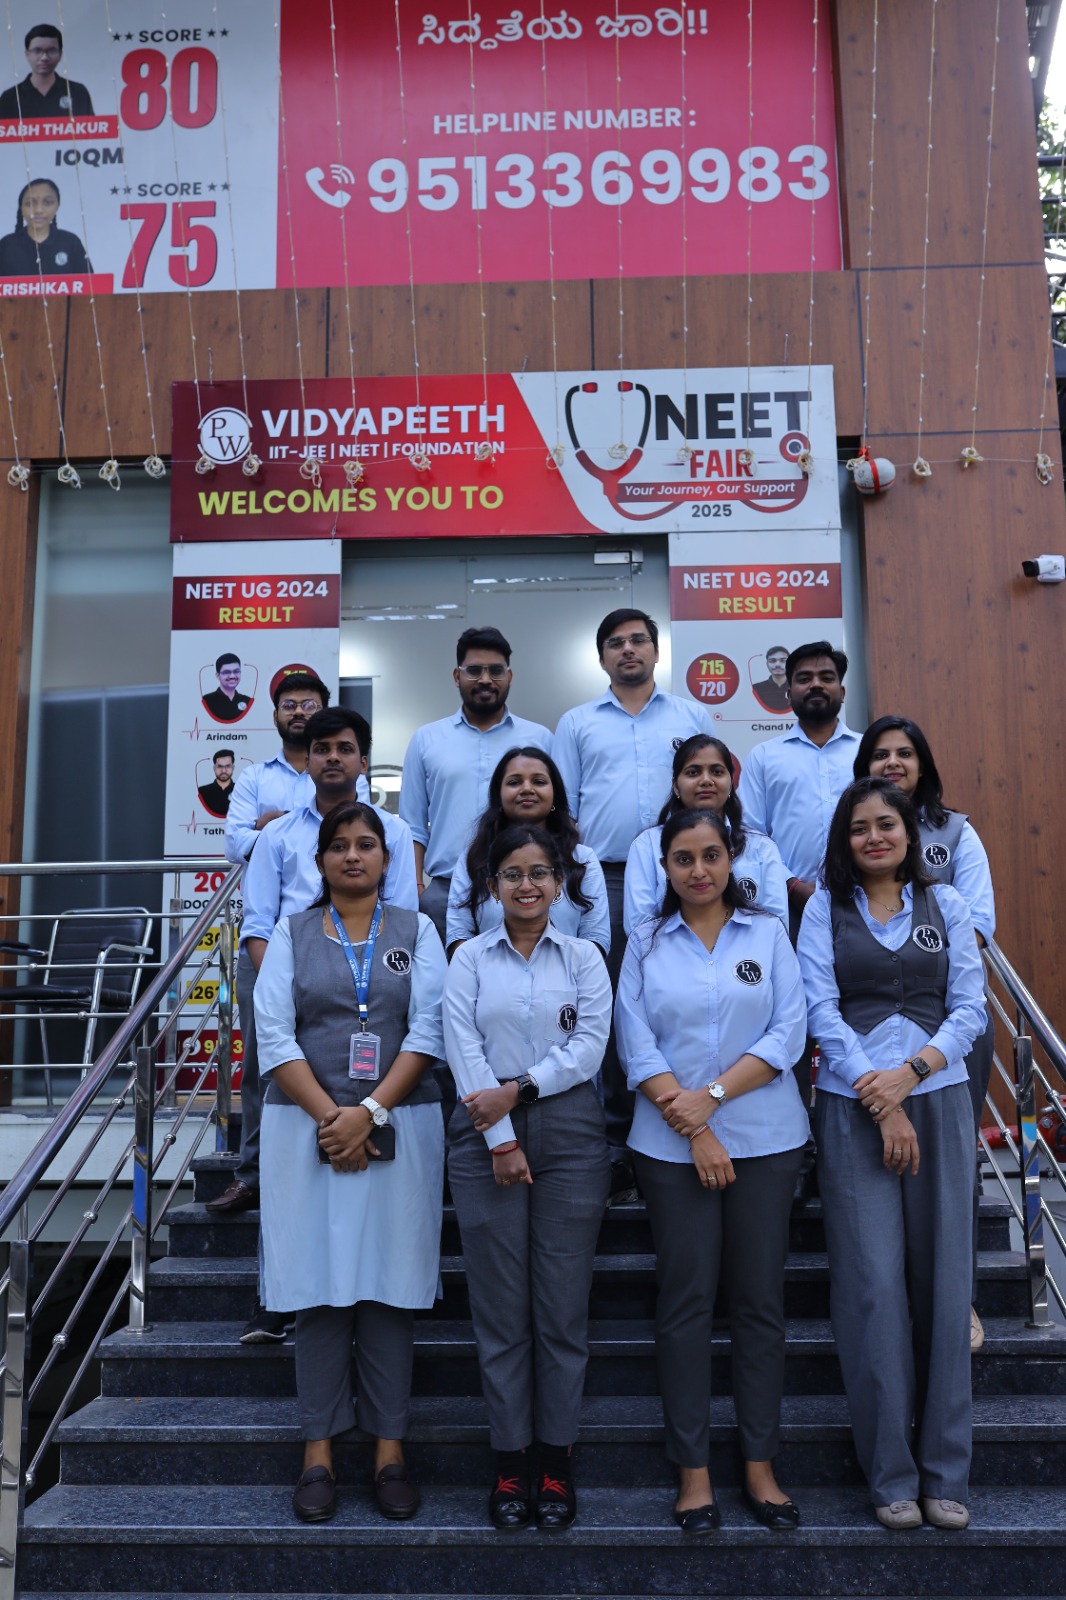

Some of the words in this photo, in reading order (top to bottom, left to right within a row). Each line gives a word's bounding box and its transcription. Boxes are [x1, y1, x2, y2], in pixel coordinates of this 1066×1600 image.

[139, 28, 202, 43] SCORE
[120, 46, 218, 131] 80
[42, 121, 109, 135] THAKUR
[433, 111, 556, 135] HELPLINE
[563, 107, 682, 130] NUMBER
[55, 147, 124, 167] IOQM
[368, 144, 830, 214] 9513369983
[137, 182, 202, 197] SCORE
[120, 201, 218, 288] 75
[0, 281, 69, 296] RISHIKA
[72, 281, 83, 293] R
[261, 404, 505, 438] VIDYAPEETH
[655, 391, 812, 441] NEET
[269, 445, 326, 459] IIT-JEE
[339, 443, 380, 458] NEET
[690, 449, 753, 478] FAIR
[625, 485, 653, 496] Your
[657, 484, 714, 497] Journey,
[716, 483, 740, 494] Our
[743, 482, 796, 495] Support
[198, 487, 376, 516] WELCOMES
[385, 486, 452, 510] YOU
[461, 485, 504, 509] TO
[691, 504, 732, 517] 2025
[683, 572, 735, 589] NEET
[740, 571, 772, 588] UG
[776, 570, 830, 587] 2024
[185, 582, 237, 600] NEET
[241, 582, 272, 598] UG
[276, 580, 329, 598] 2024
[718, 596, 796, 613] RESULT
[218, 606, 294, 624] RESULT
[700, 659, 725, 676] 715
[699, 681, 726, 697] 720
[751, 723, 784, 731] Chand
[206, 733, 248, 741] Arindam
[203, 827, 225, 835] Tath
